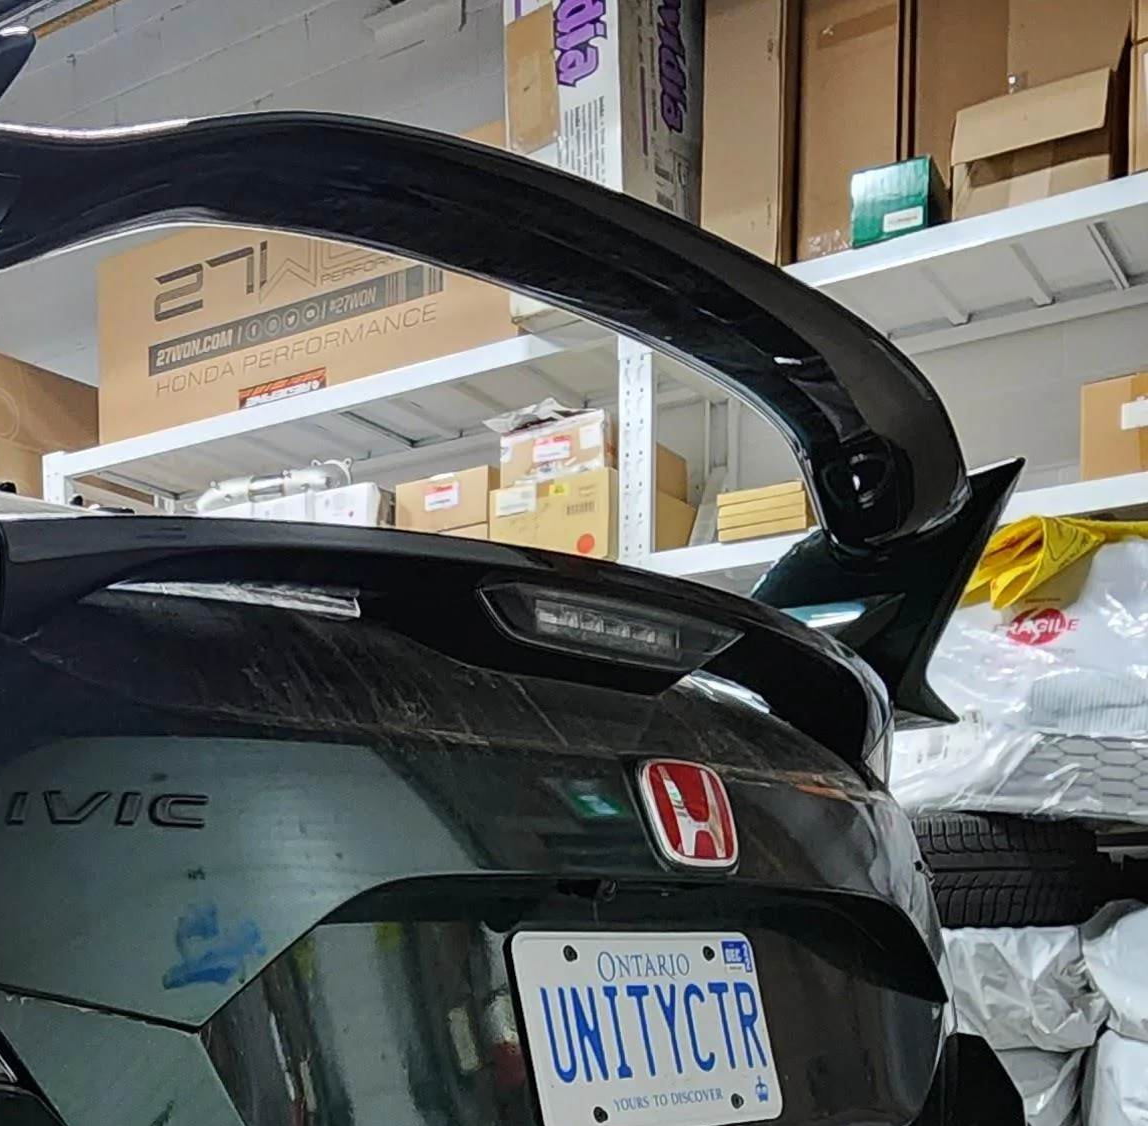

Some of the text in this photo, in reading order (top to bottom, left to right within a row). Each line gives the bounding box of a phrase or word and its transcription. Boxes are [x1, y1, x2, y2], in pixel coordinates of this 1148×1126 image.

[155, 286, 377, 367] 27WON.COM #27WON
[156, 360, 234, 397] HONDA
[242, 301, 439, 373] PERFORMANCE
[992, 618, 1080, 634] FRAGILE
[540, 982, 767, 1083] UNITYCTR
[613, 1087, 724, 1112] YOURS TO DISCOVER
